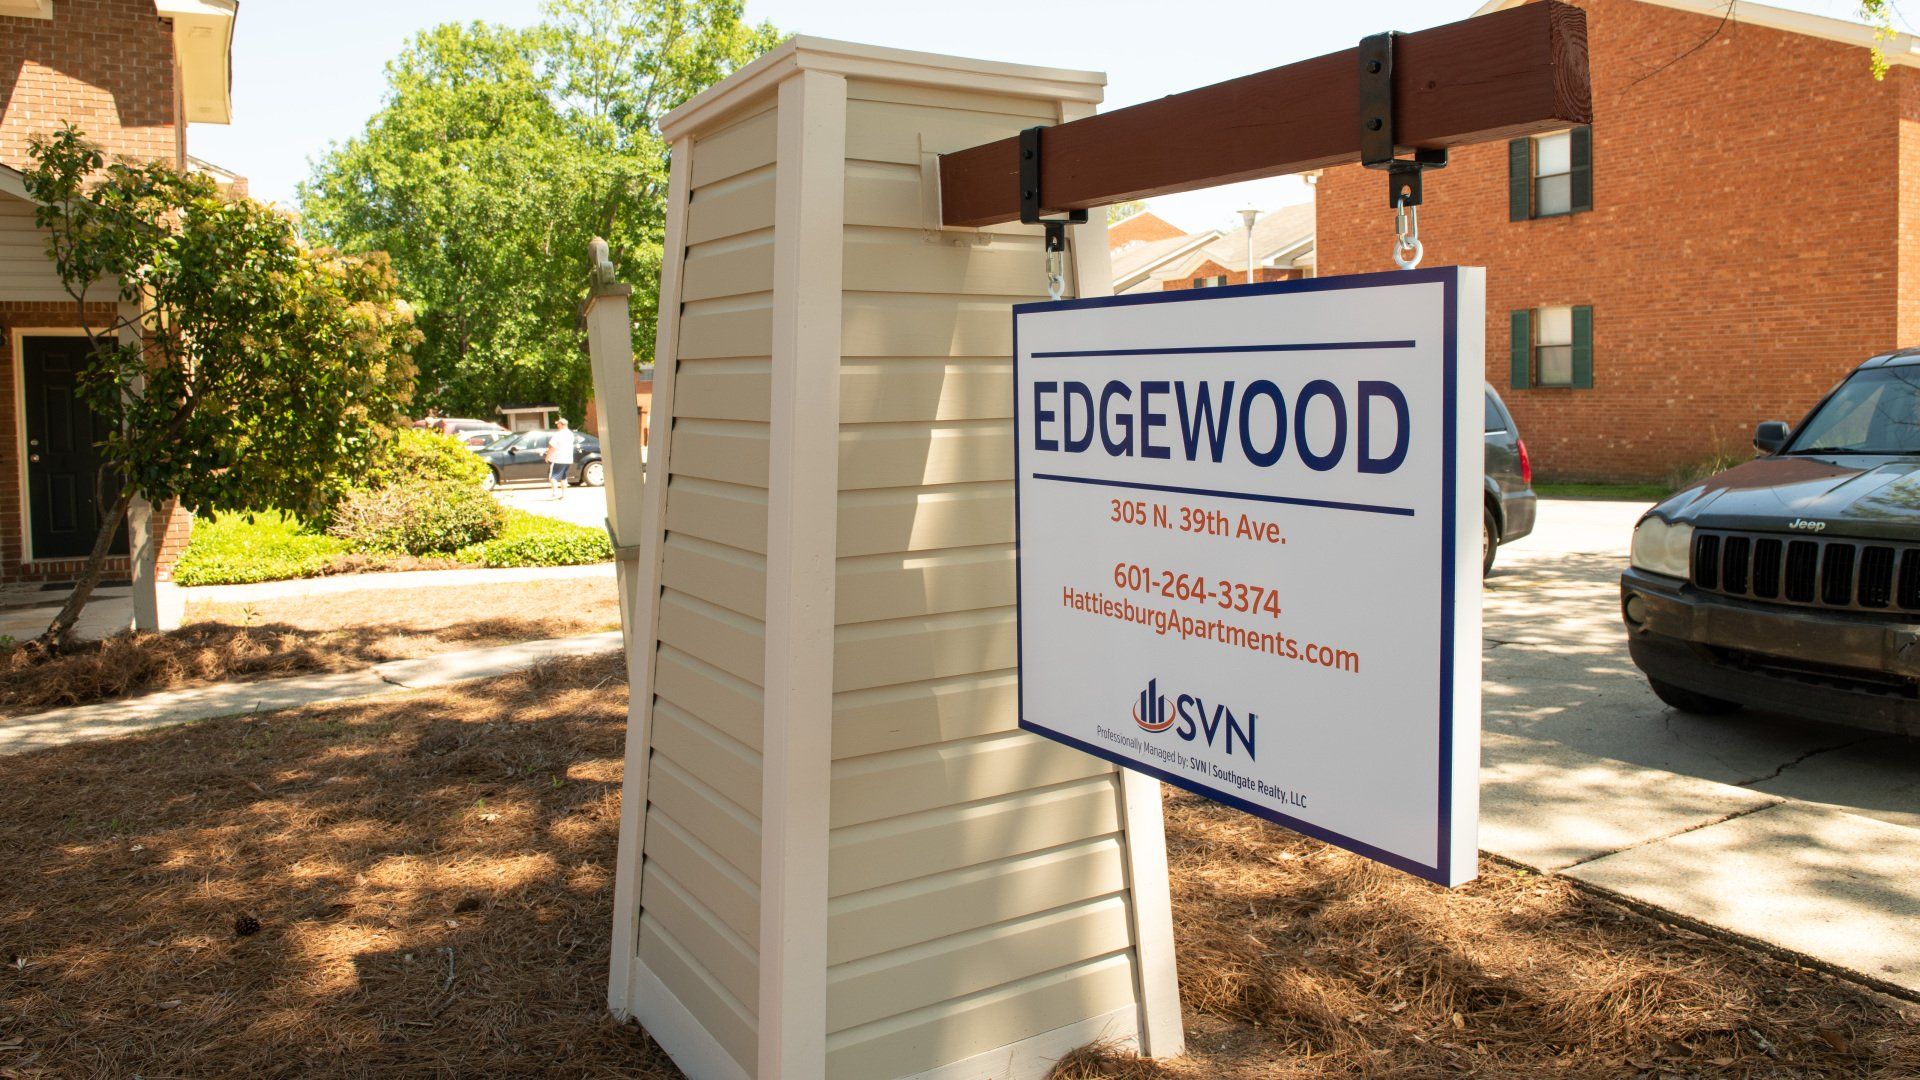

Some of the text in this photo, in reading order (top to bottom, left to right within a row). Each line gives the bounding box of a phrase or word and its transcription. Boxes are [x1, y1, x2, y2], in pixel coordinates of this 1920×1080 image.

[1033, 379, 1410, 475] EDGEWOOD
[1111, 499, 1287, 544] 305 N. 39th Ave.
[1788, 518, 1826, 532] Jeep
[1113, 563, 1282, 618] 601-264-3374
[1063, 585, 1360, 673] HattiesburgApartments.com
[1176, 693, 1256, 762] SVN
[1097, 724, 1143, 753] Professionally
[1143, 742, 1176, 763] Managed
[1177, 754, 1189, 769] by:
[1190, 757, 1207, 774] SVN
[1212, 765, 1256, 790] Southgate
[1257, 780, 1289, 804] Realty,
[1290, 791, 1308, 808] LLC
